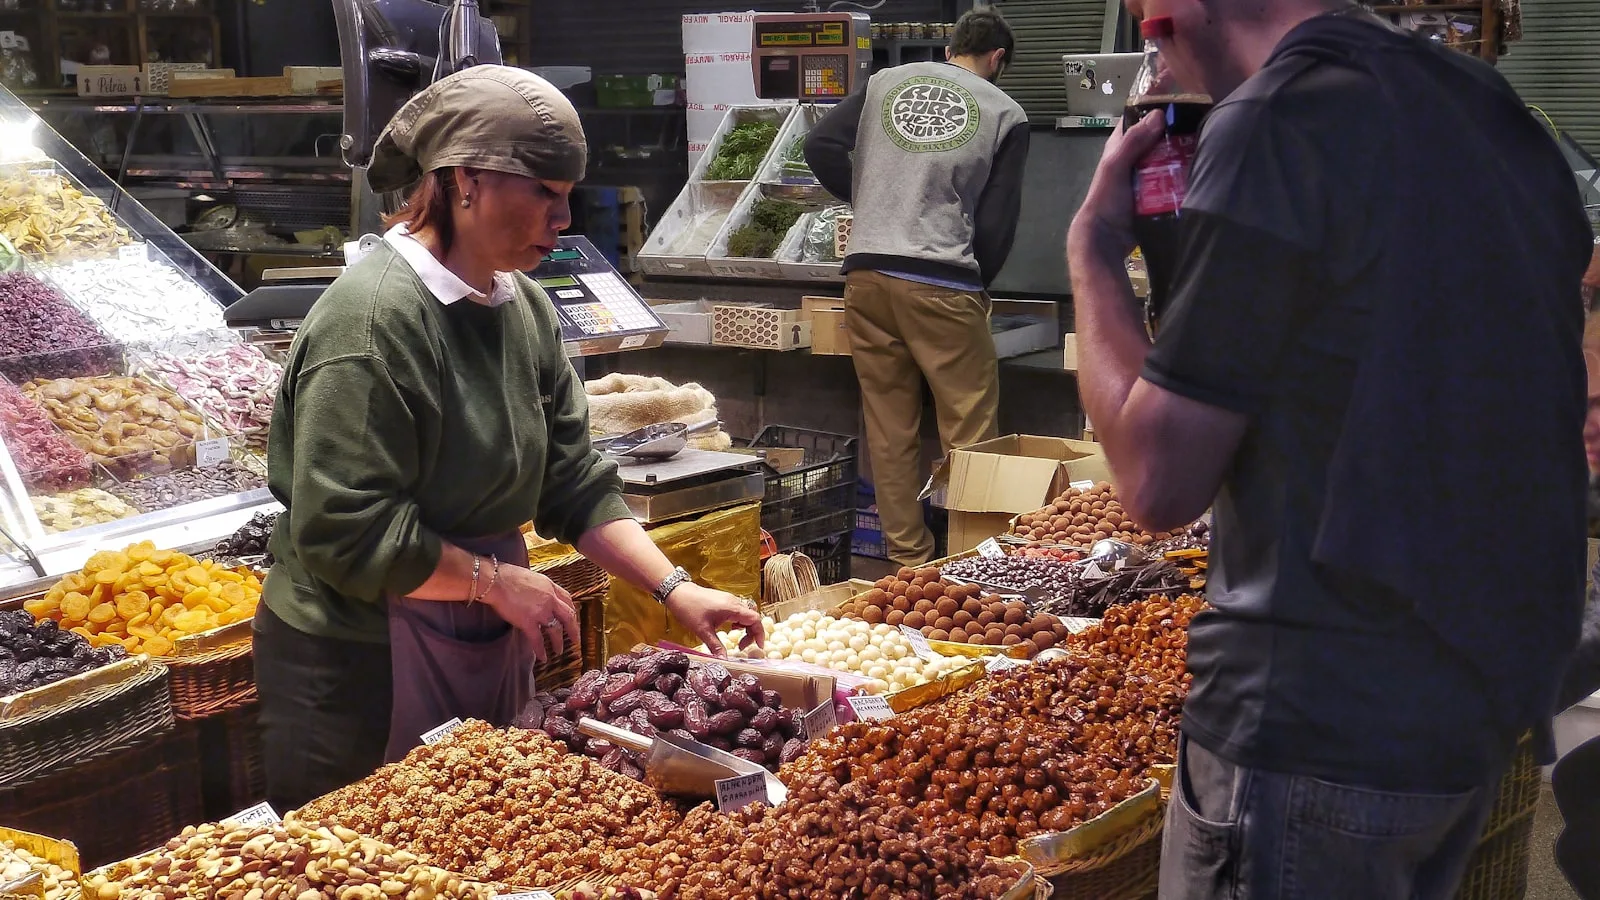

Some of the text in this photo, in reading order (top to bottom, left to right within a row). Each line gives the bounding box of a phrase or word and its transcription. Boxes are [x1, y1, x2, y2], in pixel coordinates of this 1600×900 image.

[717, 15, 743, 23] FRAGIL
[900, 85, 962, 104] RIP
[893, 100, 966, 127] CURL
[894, 113, 946, 126] WET
[902, 122, 957, 138] SUITS
